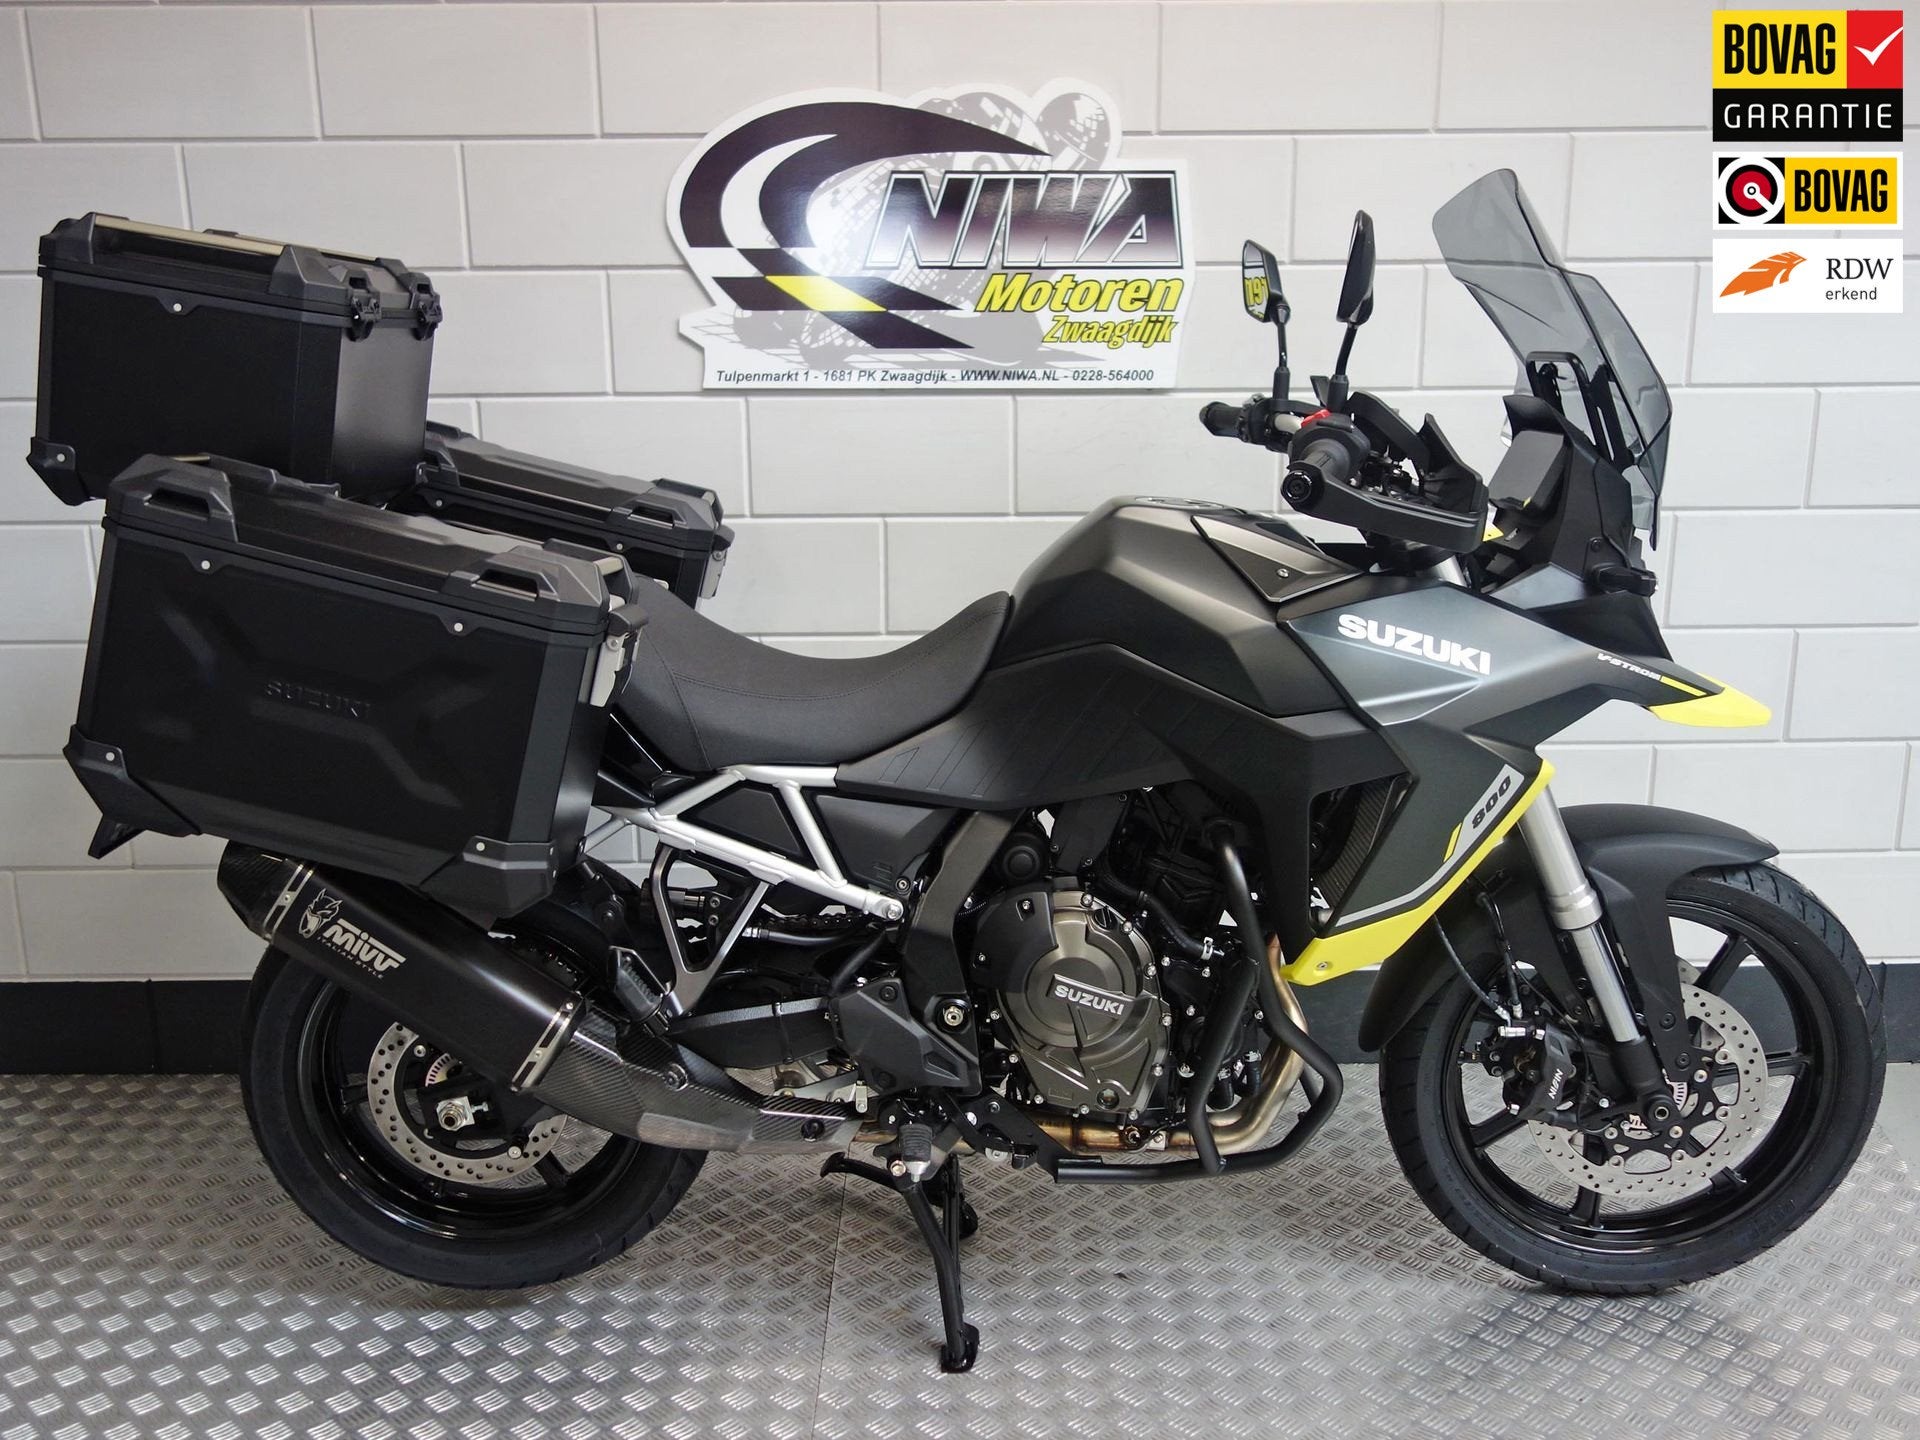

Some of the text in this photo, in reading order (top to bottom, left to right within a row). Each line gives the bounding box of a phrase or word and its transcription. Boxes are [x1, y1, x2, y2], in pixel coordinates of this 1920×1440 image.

[863, 170, 1184, 269] NIWA
[974, 273, 1185, 313] Motoren
[1042, 315, 1179, 349] Zwaagdijk
[716, 370, 799, 384] Tulpenmarkt
[803, 370, 810, 381] 1
[823, 370, 852, 381] 1681
[857, 370, 877, 381] PK
[880, 370, 947, 384] Zwaagdijk
[960, 369, 1060, 381] WWW.NIWA.NL
[1072, 369, 1154, 381] 0228-564000
[1337, 614, 1492, 676] SUZUKI
[265, 680, 371, 719] SUZUKI
[1472, 775, 1511, 829] 800
[1053, 984, 1125, 1016] SUZUKI
